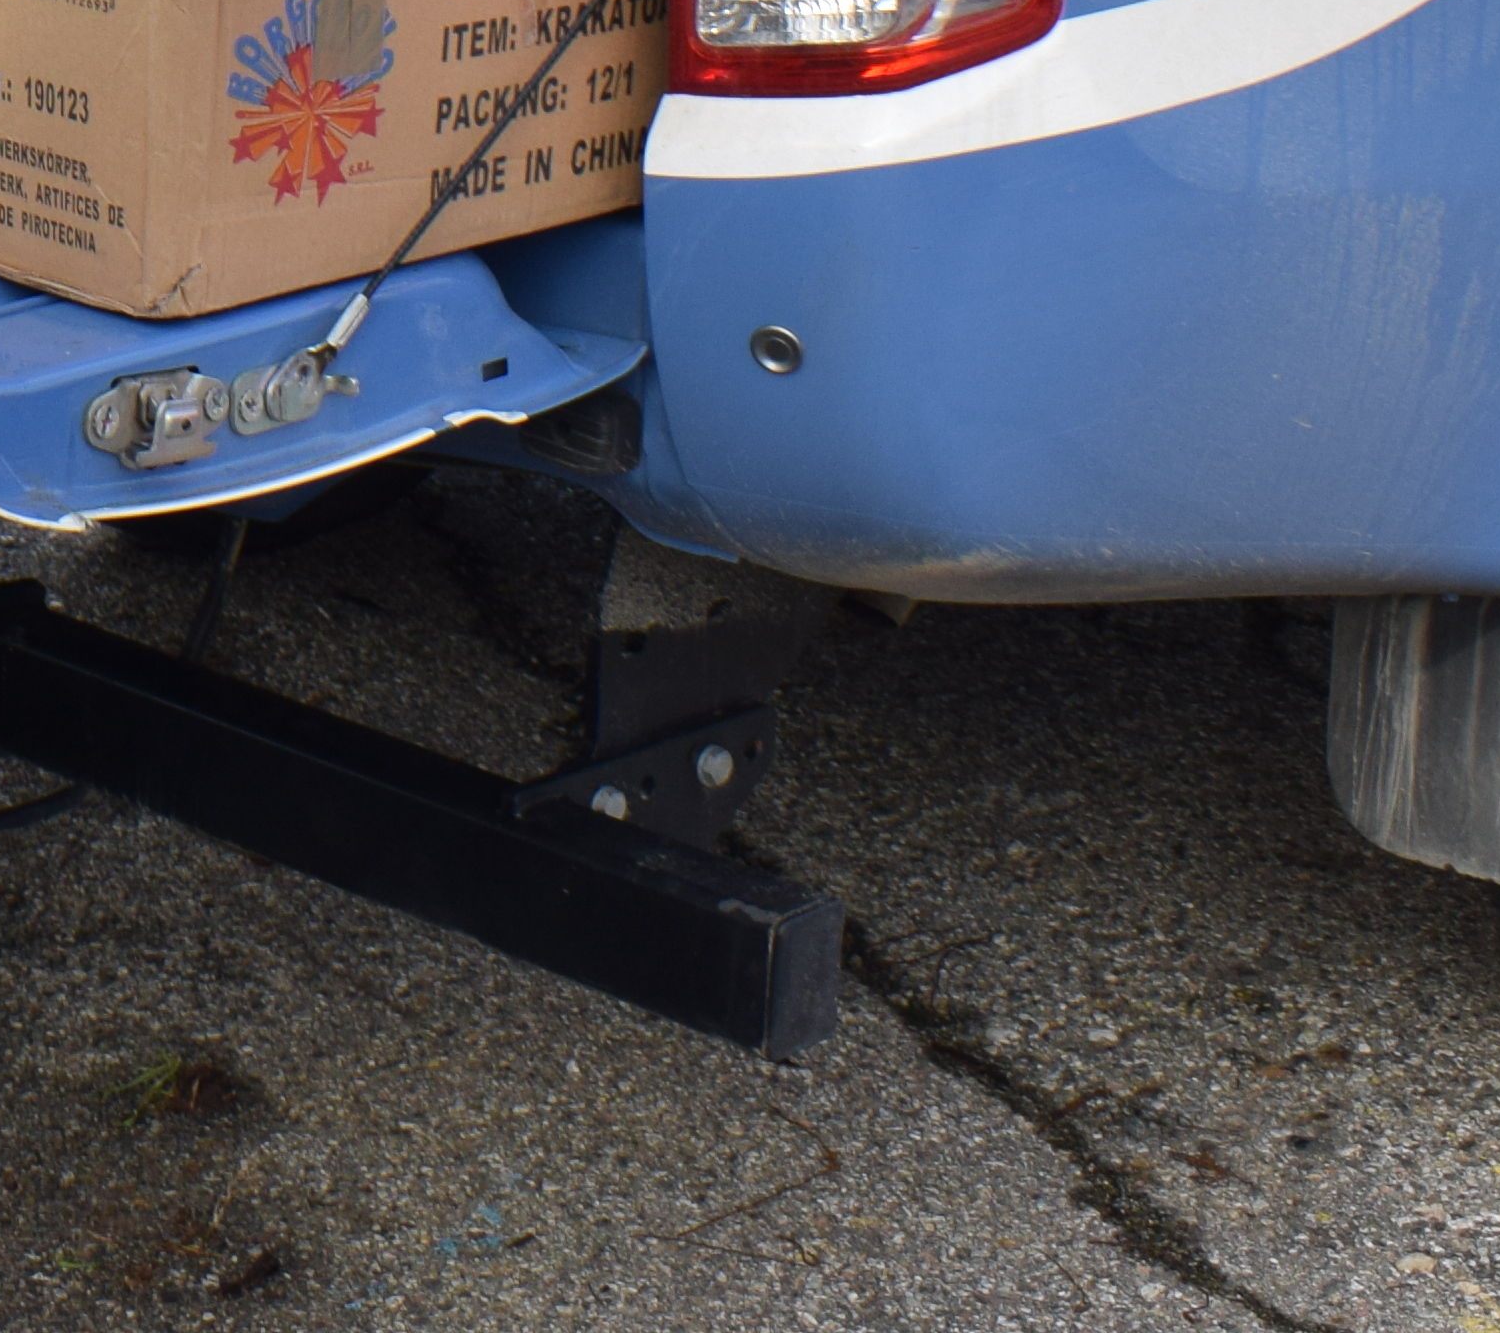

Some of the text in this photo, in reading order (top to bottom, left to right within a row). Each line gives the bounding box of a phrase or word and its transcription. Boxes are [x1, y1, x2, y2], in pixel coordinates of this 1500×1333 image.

[441, 16, 517, 63] ITEM:
[24, 76, 89, 124] 190123
[587, 60, 634, 104] 12/1
[430, 156, 507, 206] MADE
[524, 146, 553, 184] IN
[35, 182, 100, 222] ARTIFICES
[107, 203, 125, 228] DE
[22, 210, 97, 253] PIROTECNIA
